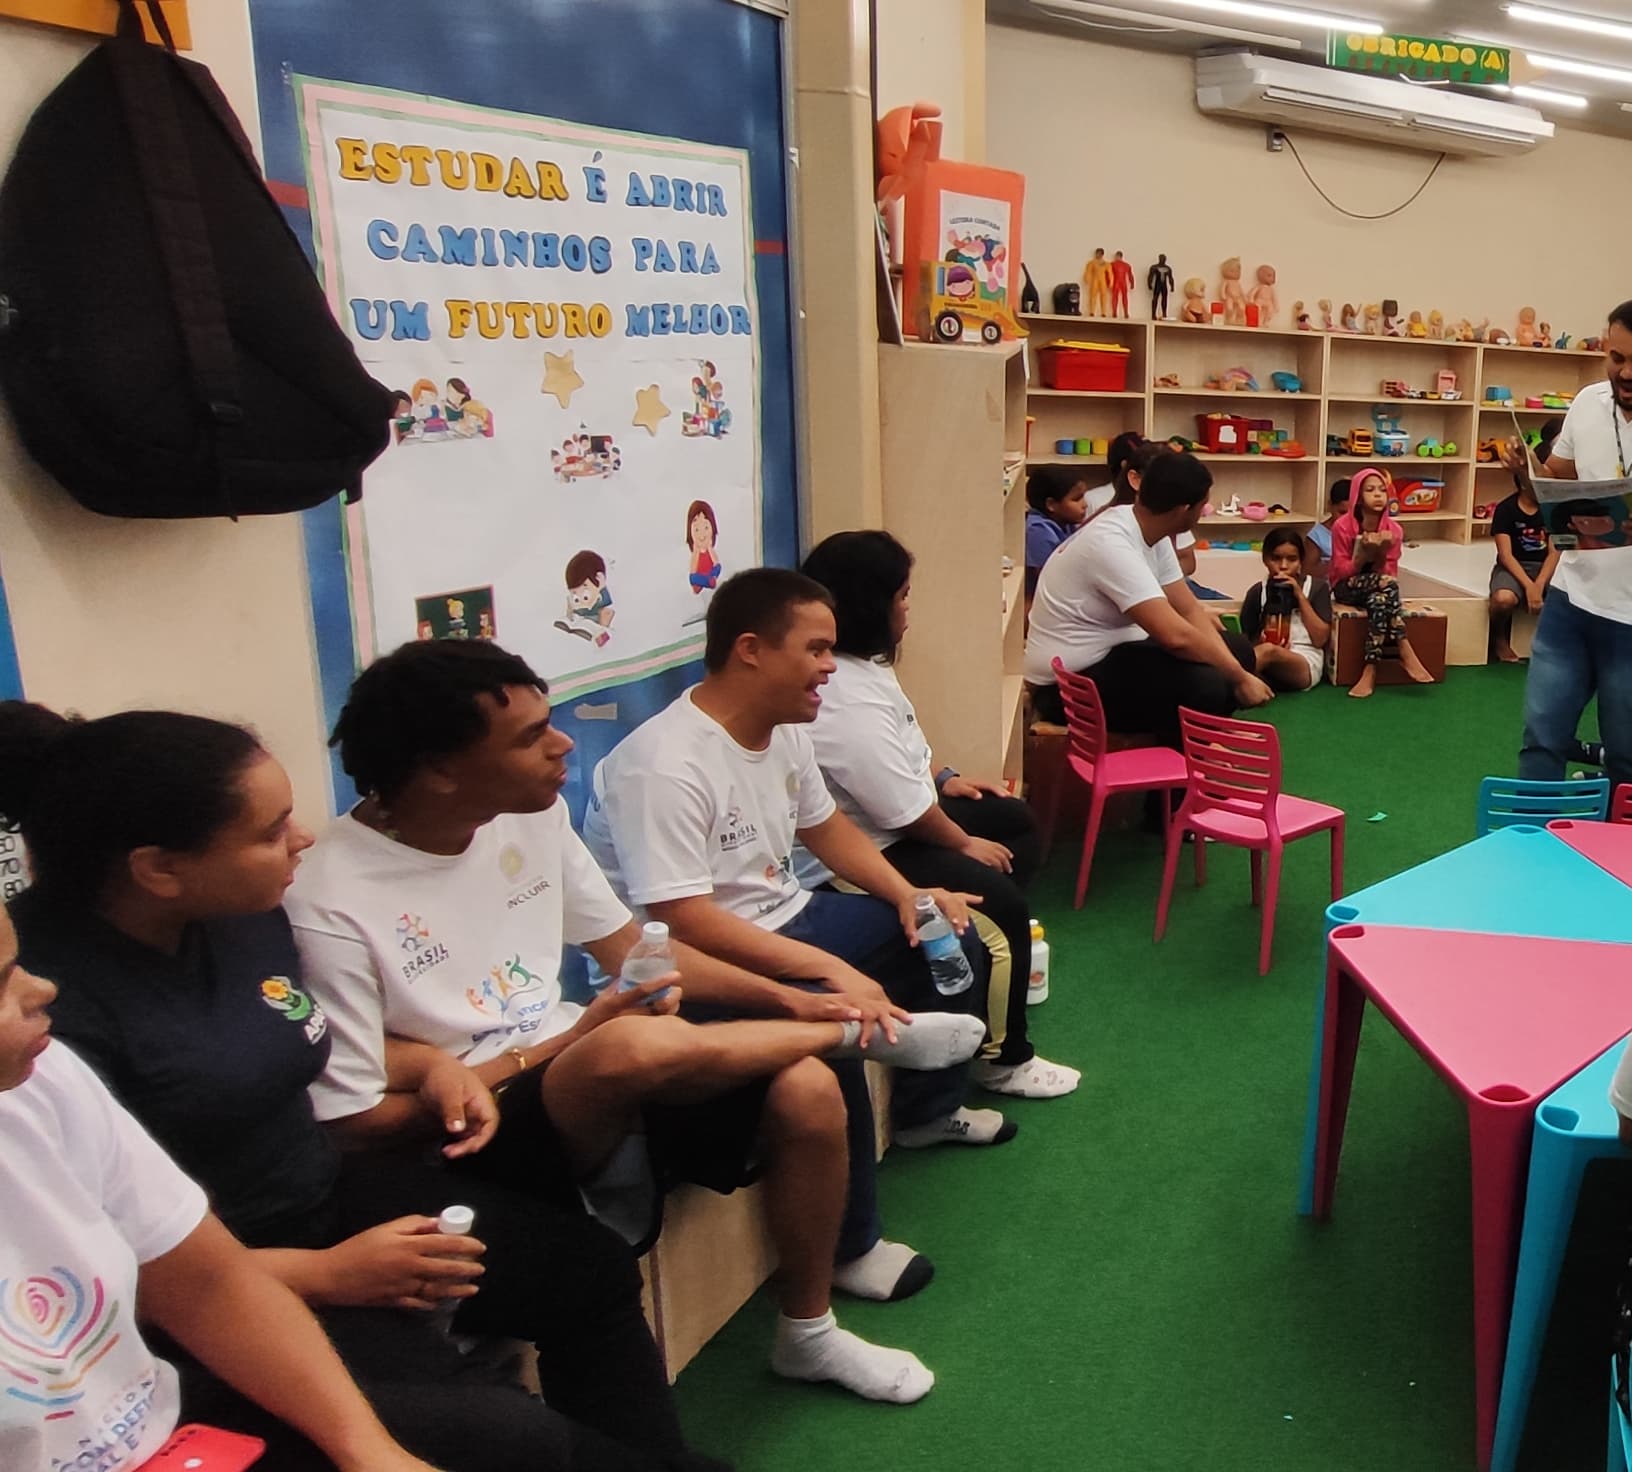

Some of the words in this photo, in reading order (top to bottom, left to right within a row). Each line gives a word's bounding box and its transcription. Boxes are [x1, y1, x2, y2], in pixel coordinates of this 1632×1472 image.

[1346, 34, 1477, 65] OBRIGADO
[336, 137, 569, 200] ESTUDAR
[584, 151, 608, 203] É
[626, 172, 727, 217] ABRIR
[366, 219, 612, 274] CAMINHOS
[633, 237, 721, 274] PARA
[350, 299, 431, 341] UM
[444, 300, 612, 339] FUTURO
[625, 303, 751, 337] MELHOR
[401, 942, 449, 979] BRASIL
